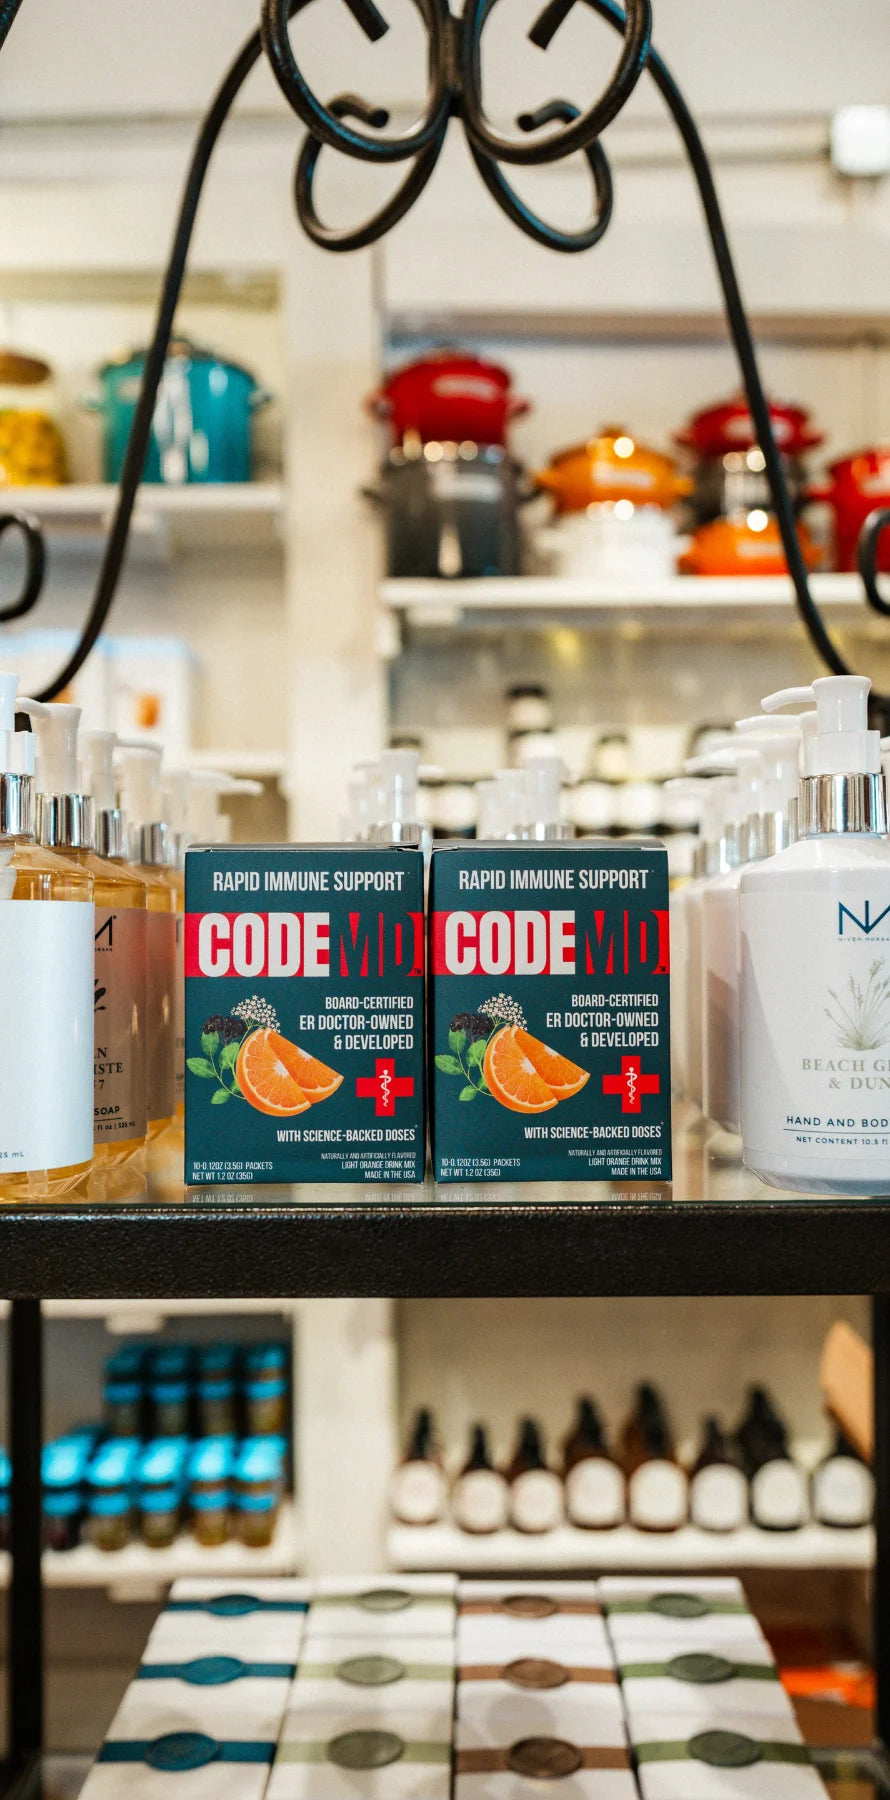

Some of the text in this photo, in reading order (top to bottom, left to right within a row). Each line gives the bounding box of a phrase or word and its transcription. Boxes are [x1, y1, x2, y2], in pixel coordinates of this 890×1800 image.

[213, 871, 404, 891] RAPID IMMUNE SUPPORT
[459, 869, 648, 890] RAPID IMMUNE SUPPORT
[325, 996, 414, 1010] BOARD-CERTIFIED
[571, 994, 659, 1007] BOARD-CERTIFIED
[300, 1014, 414, 1030] ER DOCTOR-OWNED
[546, 1011, 659, 1028] ER DOCTOR-OWNED
[334, 1034, 414, 1050] & DEVELOPED
[580, 1032, 659, 1047] & DEVELOPED
[802, 1058, 865, 1072] BEACH
[829, 1077, 840, 1090] &
[94, 1105, 120, 1116] SOAP
[786, 1115, 821, 1126] HAND
[826, 1118, 855, 1127] AND
[277, 1128, 415, 1142] WITH SCIENCE-BACKED DOSES
[524, 1125, 661, 1139] WITH SCIENCE-BACKED DOSES
[796, 1135, 812, 1143] NET
[815, 1137, 857, 1145] CONTENT
[321, 1152, 348, 1160] NATURALLY
[391, 1151, 416, 1159] FLAVORED
[568, 1149, 595, 1157] NATURALLY
[638, 1148, 662, 1156] FLAVORED
[245, 1162, 273, 1170] PACKETS
[341, 1160, 416, 1169] LIGHT ORANGE DRINK MIX
[493, 1158, 520, 1167] PACKETS
[588, 1157, 661, 1166] LIGHT ORANGE DRINK MIX
[192, 1172, 204, 1180] NET
[205, 1172, 215, 1180] WT
[217, 1172, 225, 1180] 1.2
[226, 1172, 235, 1180] OZ
[364, 1171, 382, 1179] MADE
[440, 1169, 452, 1177] NET
[453, 1169, 463, 1177] WT
